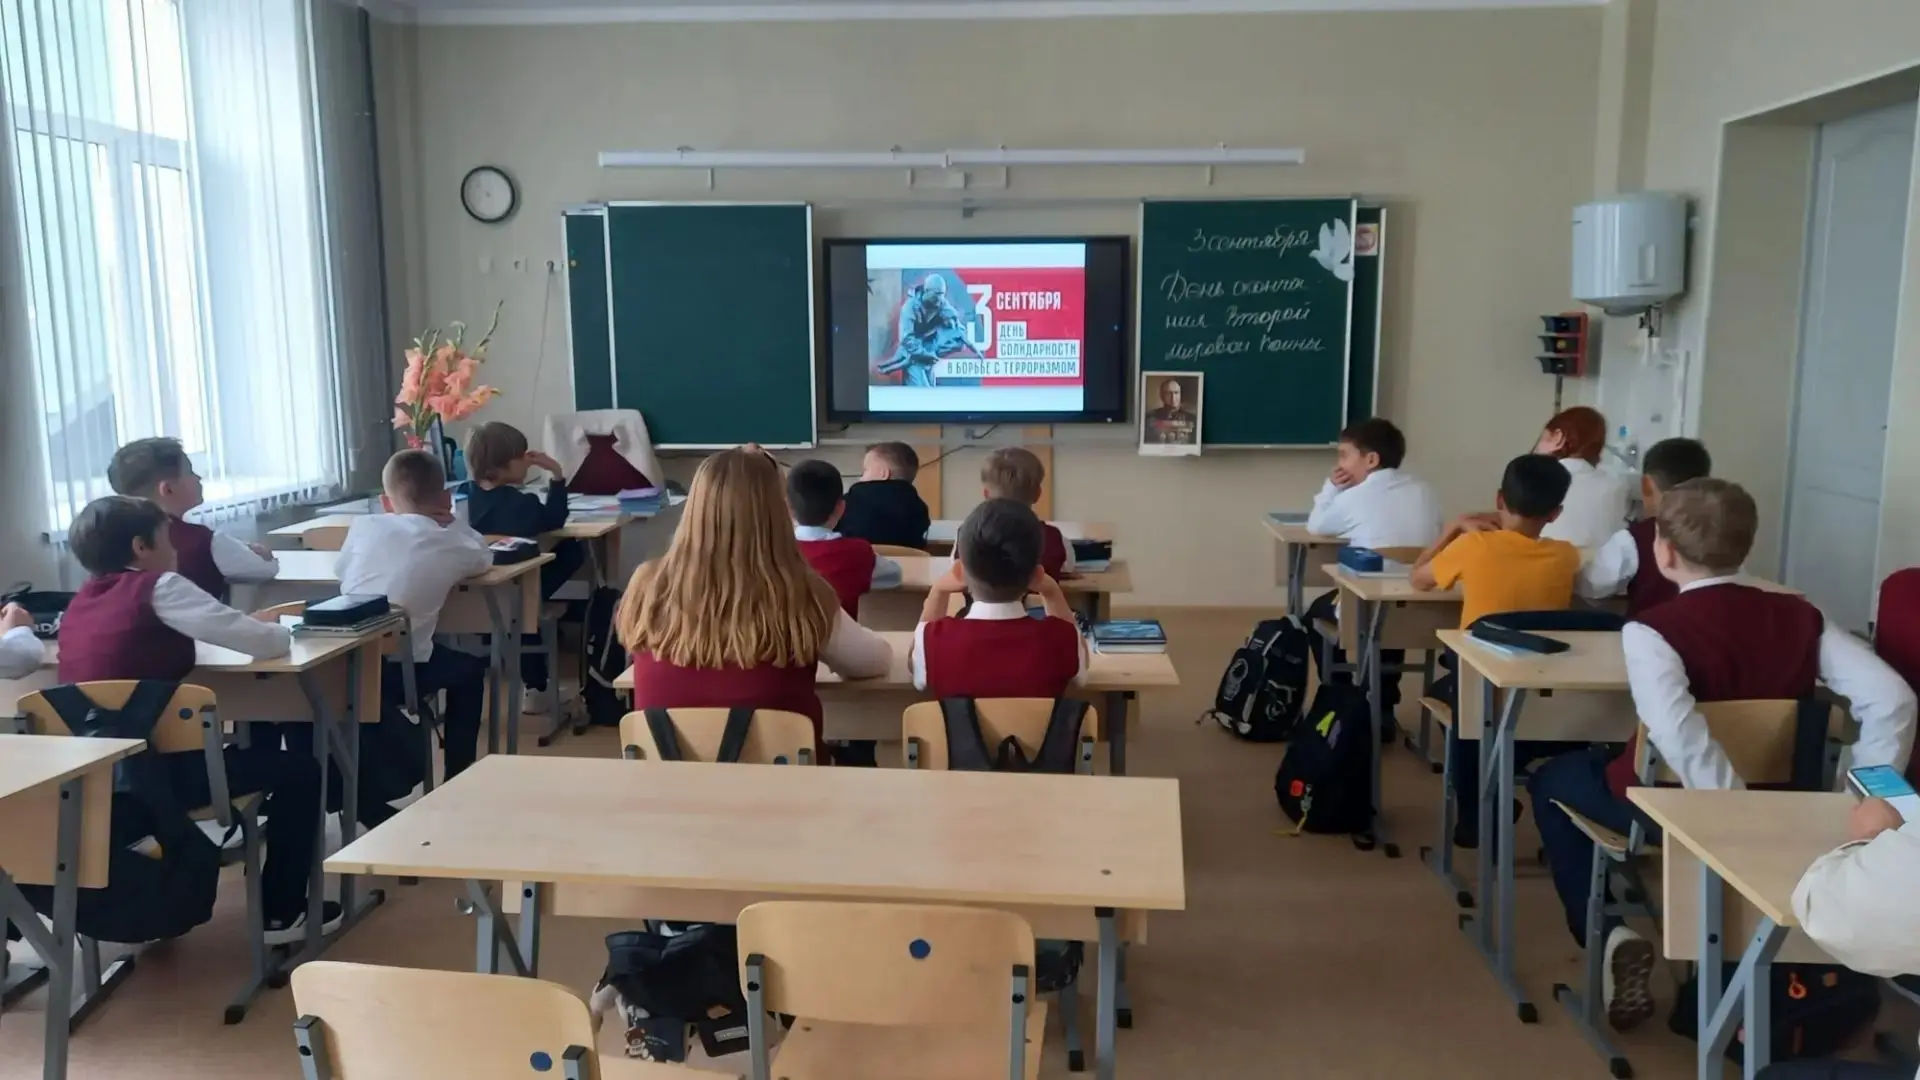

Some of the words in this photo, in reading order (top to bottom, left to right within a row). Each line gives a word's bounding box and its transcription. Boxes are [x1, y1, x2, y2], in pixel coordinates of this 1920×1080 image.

[1188, 227, 1206, 252] 3
[1207, 224, 1313, 258] сентября
[1160, 269, 1225, 303] День
[966, 284, 993, 352] 3
[996, 291, 1062, 311] СЕНТЯБРЯ
[1000, 324, 1025, 339] ДЕНЬ
[1166, 313, 1208, 330] ния
[1225, 301, 1312, 333] Второй
[1000, 343, 1077, 358] СОЛИДАРНОСТИ
[947, 361, 953, 375] В
[956, 361, 991, 375] БОРЬБЕ
[994, 361, 1000, 375] С
[1003, 361, 1077, 375] ТЕРРОРИЗМОМ
